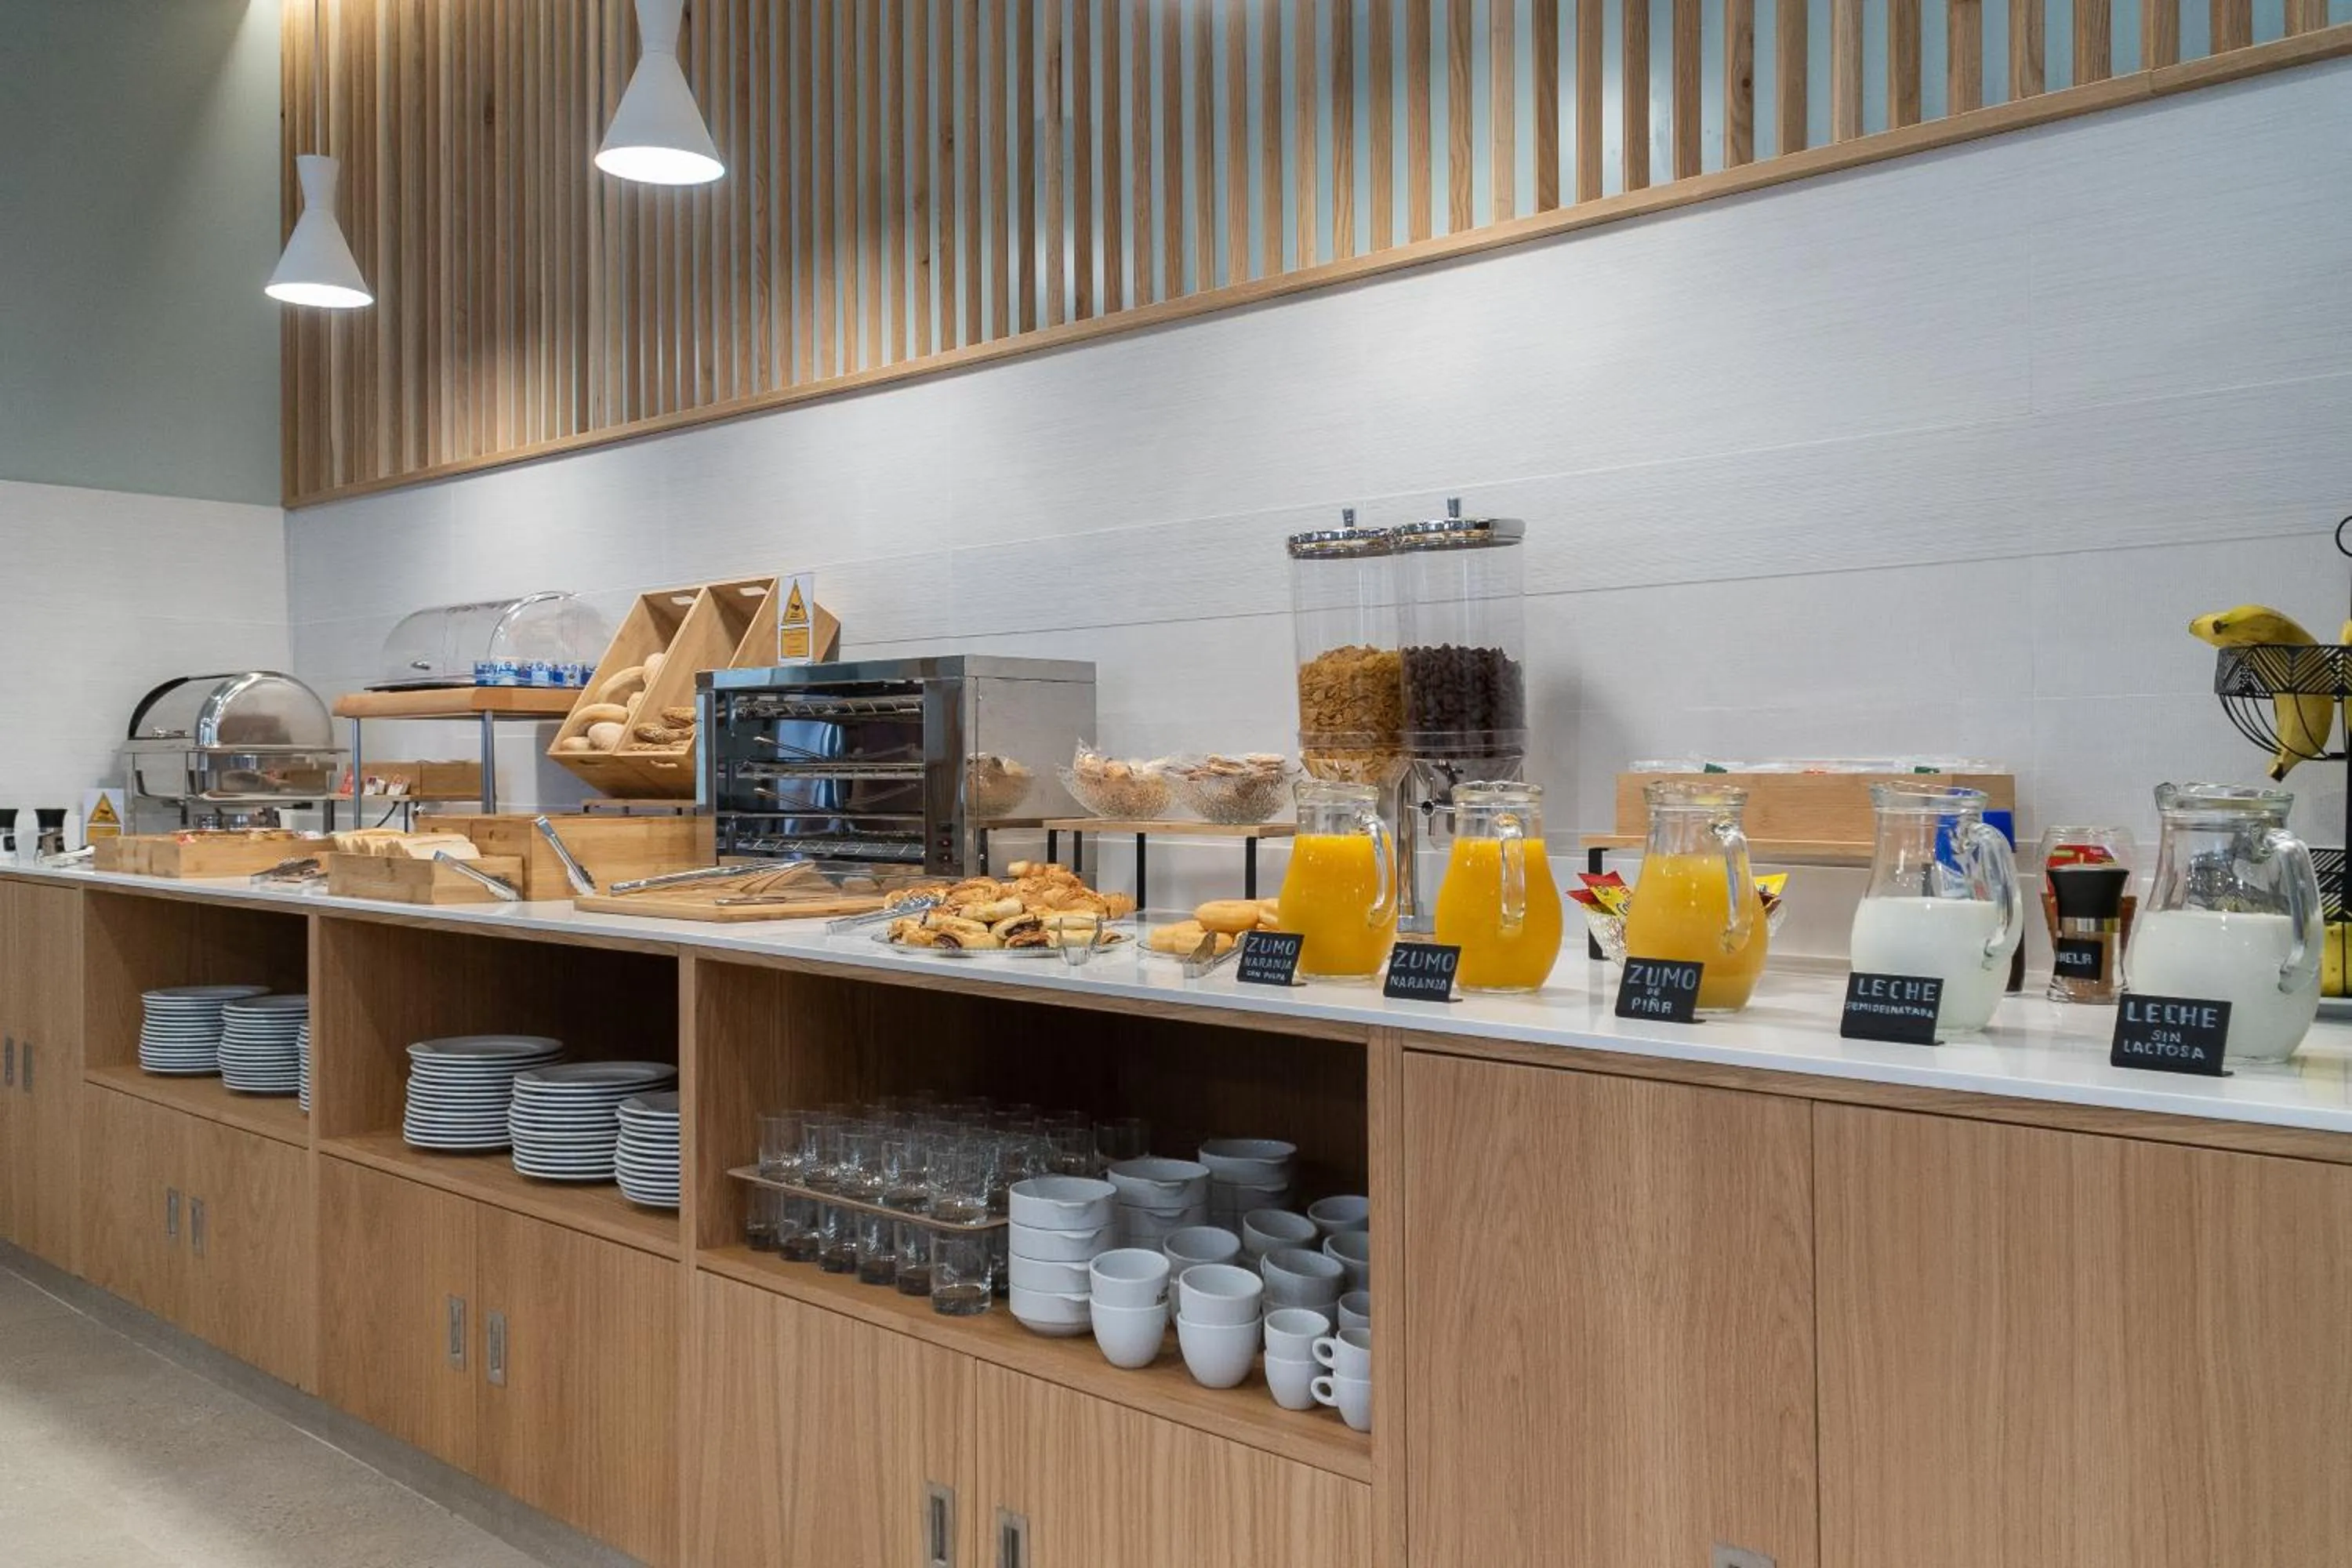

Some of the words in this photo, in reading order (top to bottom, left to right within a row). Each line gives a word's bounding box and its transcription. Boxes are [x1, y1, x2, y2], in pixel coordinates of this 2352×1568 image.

[1247, 937, 1296, 956] ZUMO
[1245, 957, 1292, 971] NARANJA
[1393, 949, 1456, 972] ZUMO
[1390, 975, 1447, 991] NARANJA
[1627, 964, 1697, 990] ZUMO
[1857, 978, 1937, 1002] LECHE
[1632, 996, 1673, 1014] PIÑA
[2125, 1001, 2219, 1029] LECHE
[2151, 1029, 2182, 1044] SIN
[2123, 1039, 2206, 1060] LACTOSA
